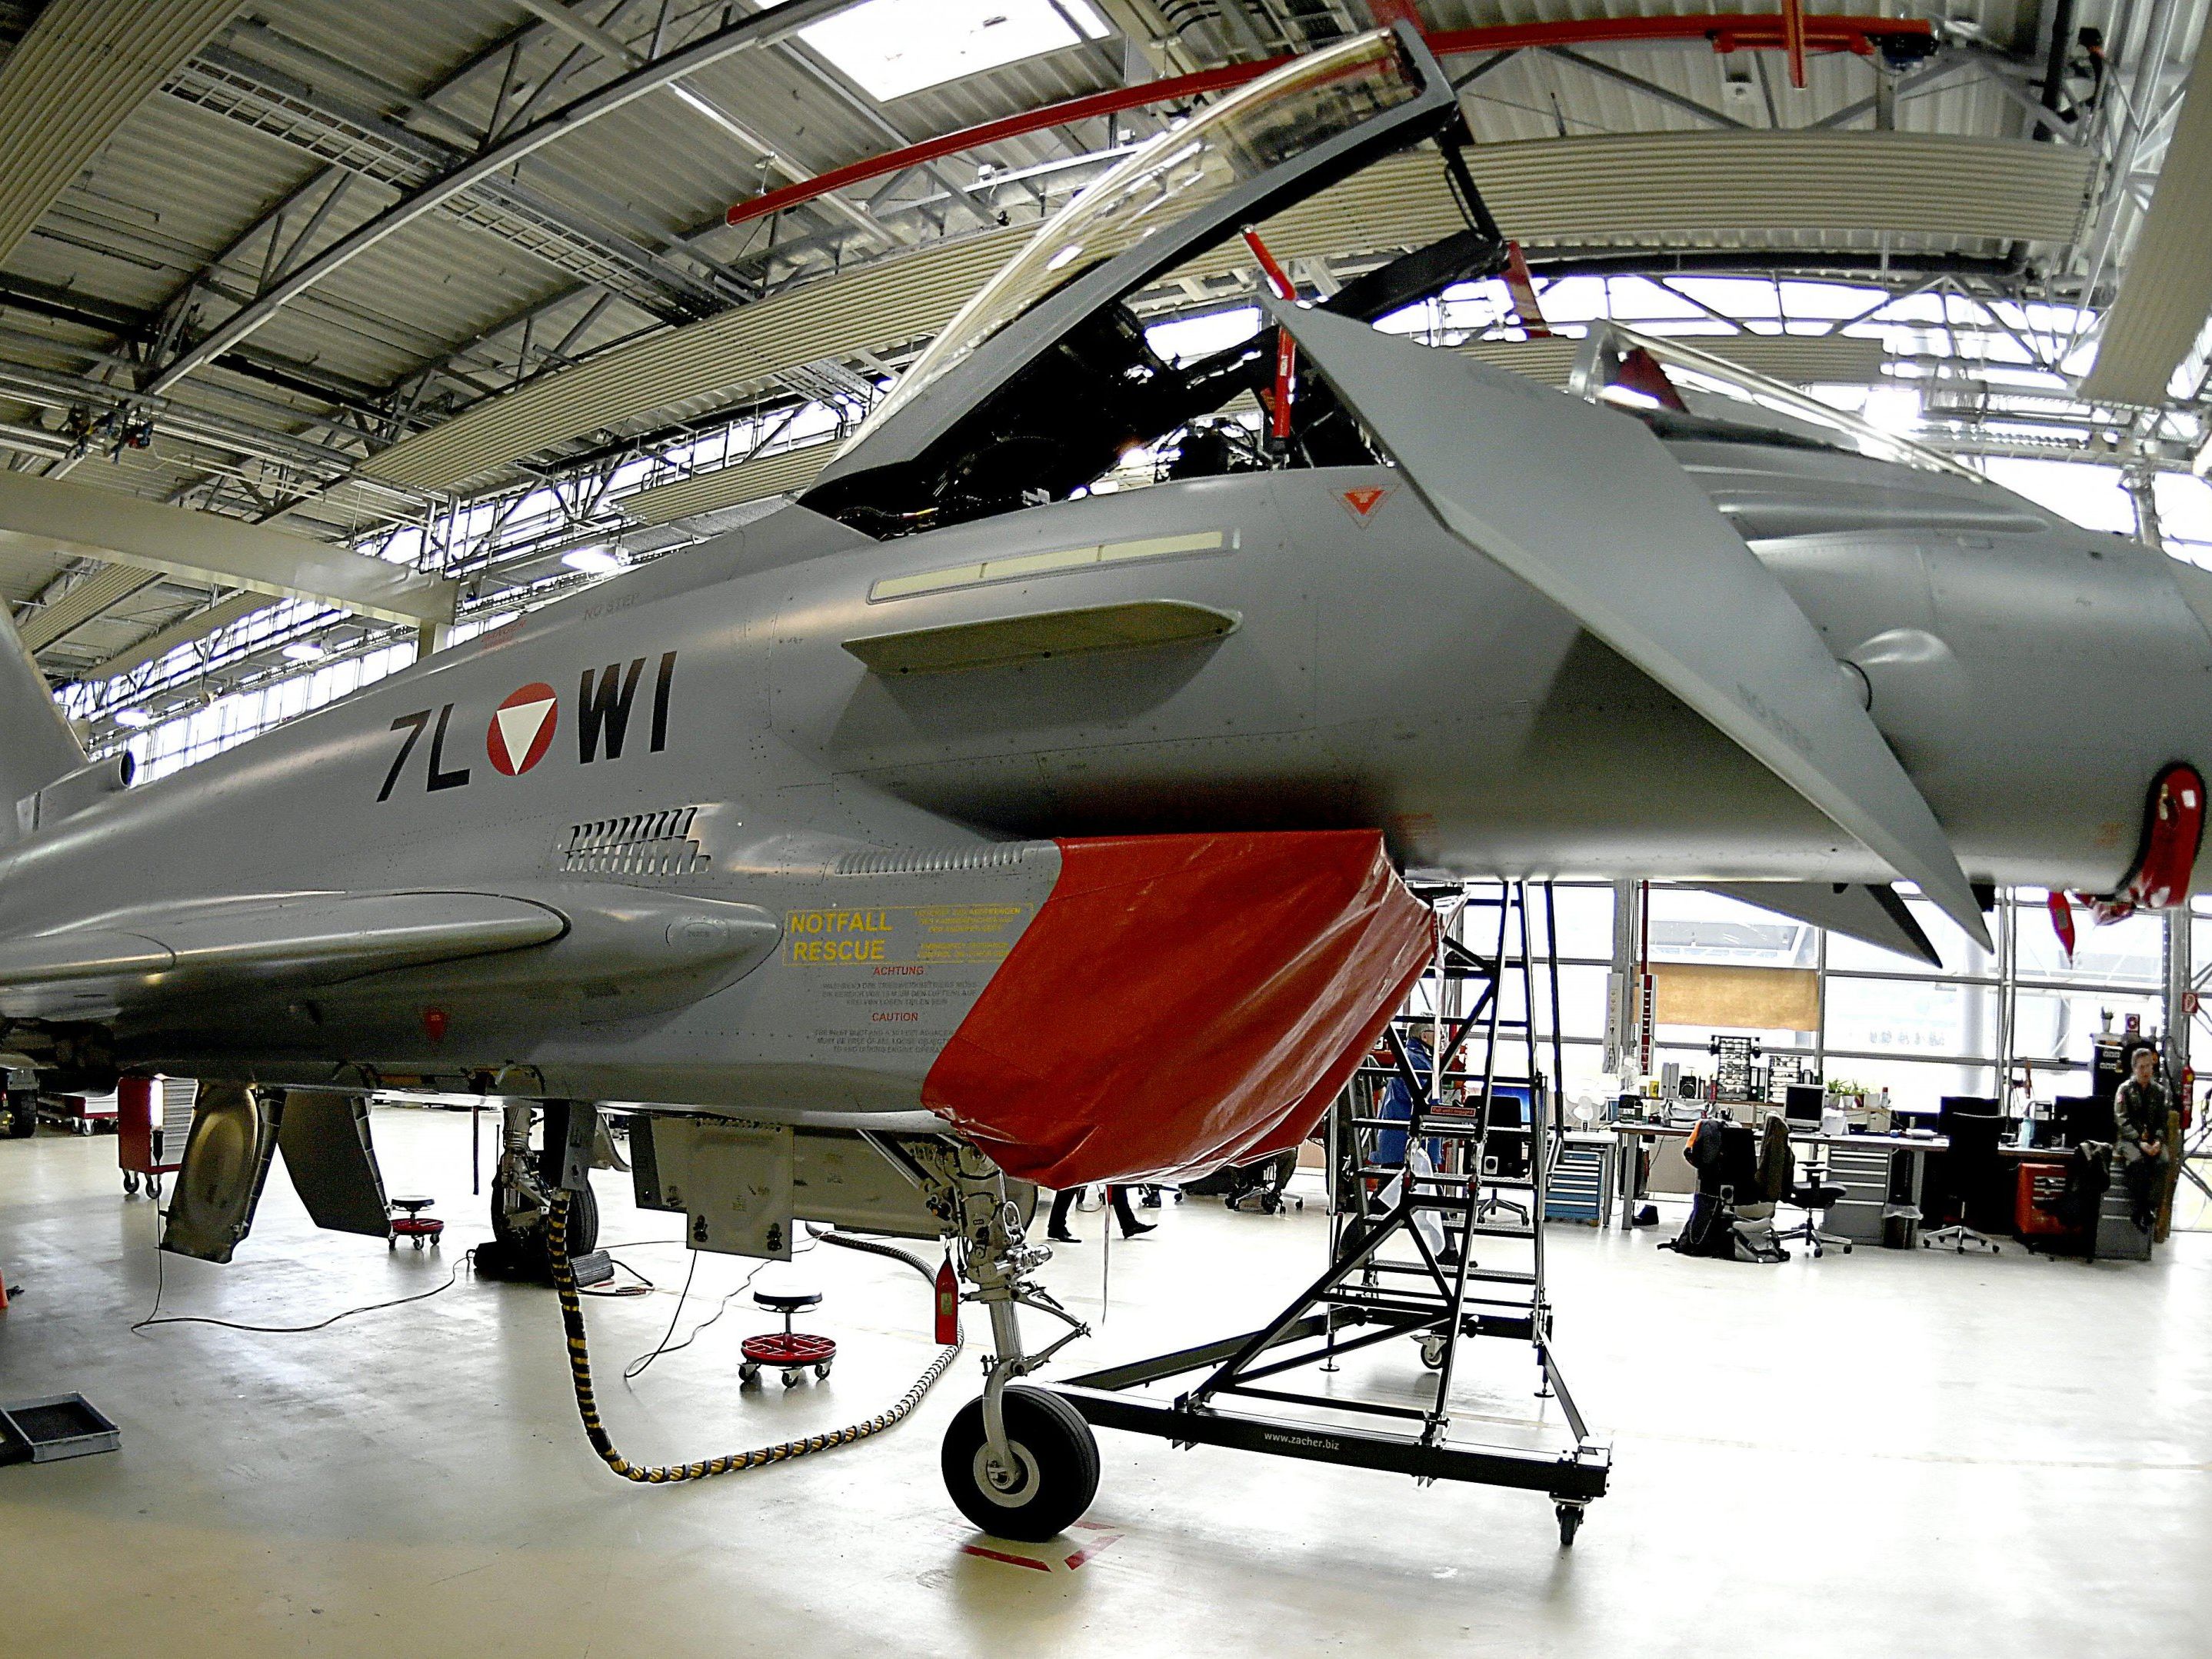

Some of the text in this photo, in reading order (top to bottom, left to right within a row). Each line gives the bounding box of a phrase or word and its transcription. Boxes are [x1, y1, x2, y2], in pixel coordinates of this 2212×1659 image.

[376, 651, 678, 802] 7L WI
[791, 912, 893, 934] NOTFALL
[793, 939, 886, 961] RESCUE
[873, 965, 924, 976] ACHTUNG
[872, 1011, 918, 1022] CAUTION
[1264, 1432, 1340, 1451] www.zacher.biz
